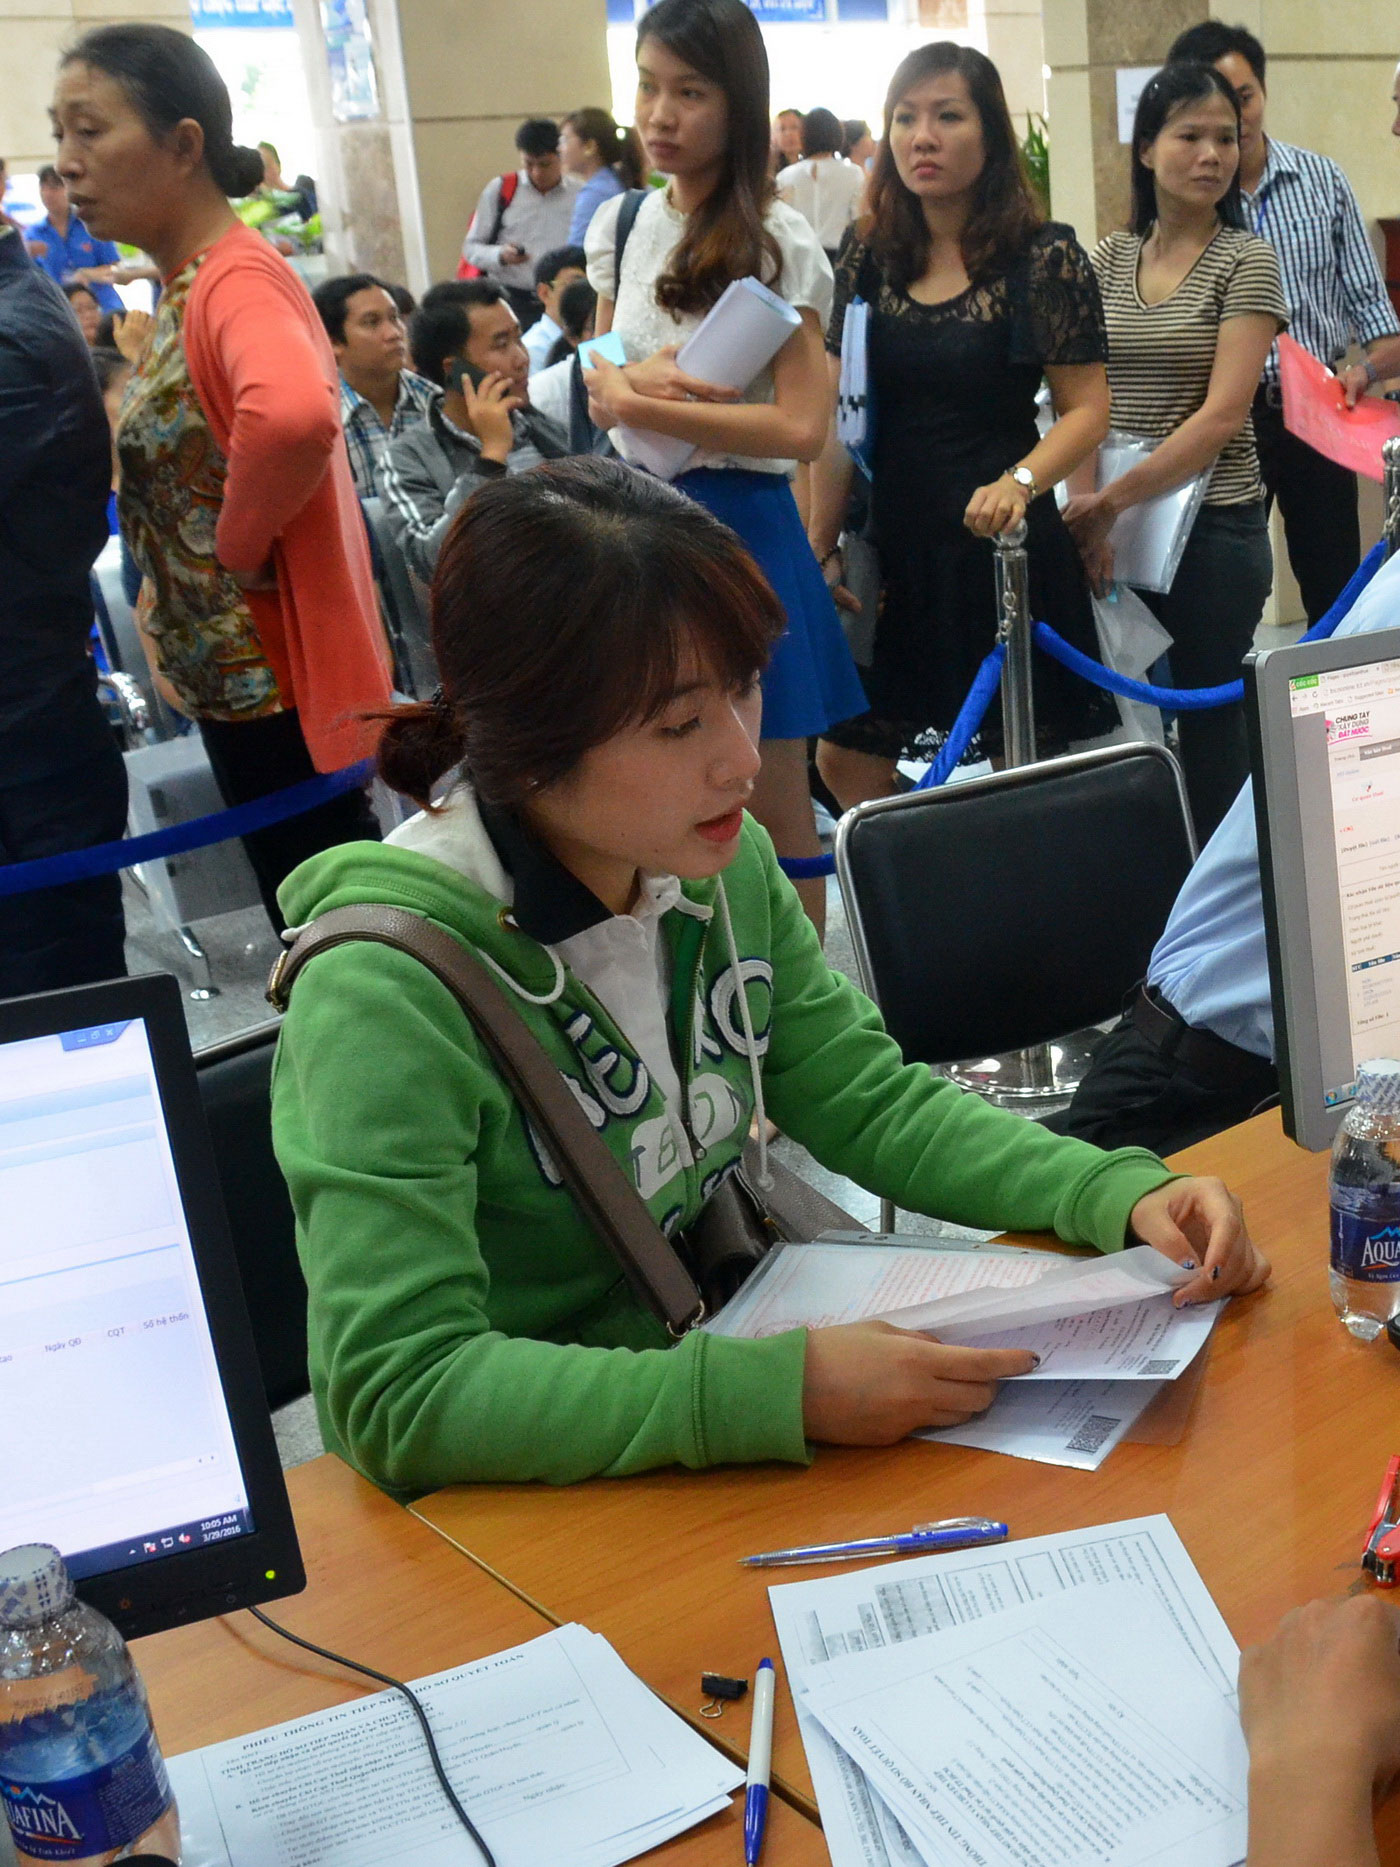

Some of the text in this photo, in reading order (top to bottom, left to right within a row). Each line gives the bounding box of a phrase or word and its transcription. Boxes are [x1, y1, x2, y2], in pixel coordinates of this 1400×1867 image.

[1336, 711, 1370, 724] CHUNG TAY
[107, 1327, 125, 1338] CQT
[200, 1514, 237, 1531] 10:05 AM
[203, 1525, 241, 1542] 3/29/2016
[3, 1798, 82, 1840] UAFINA
